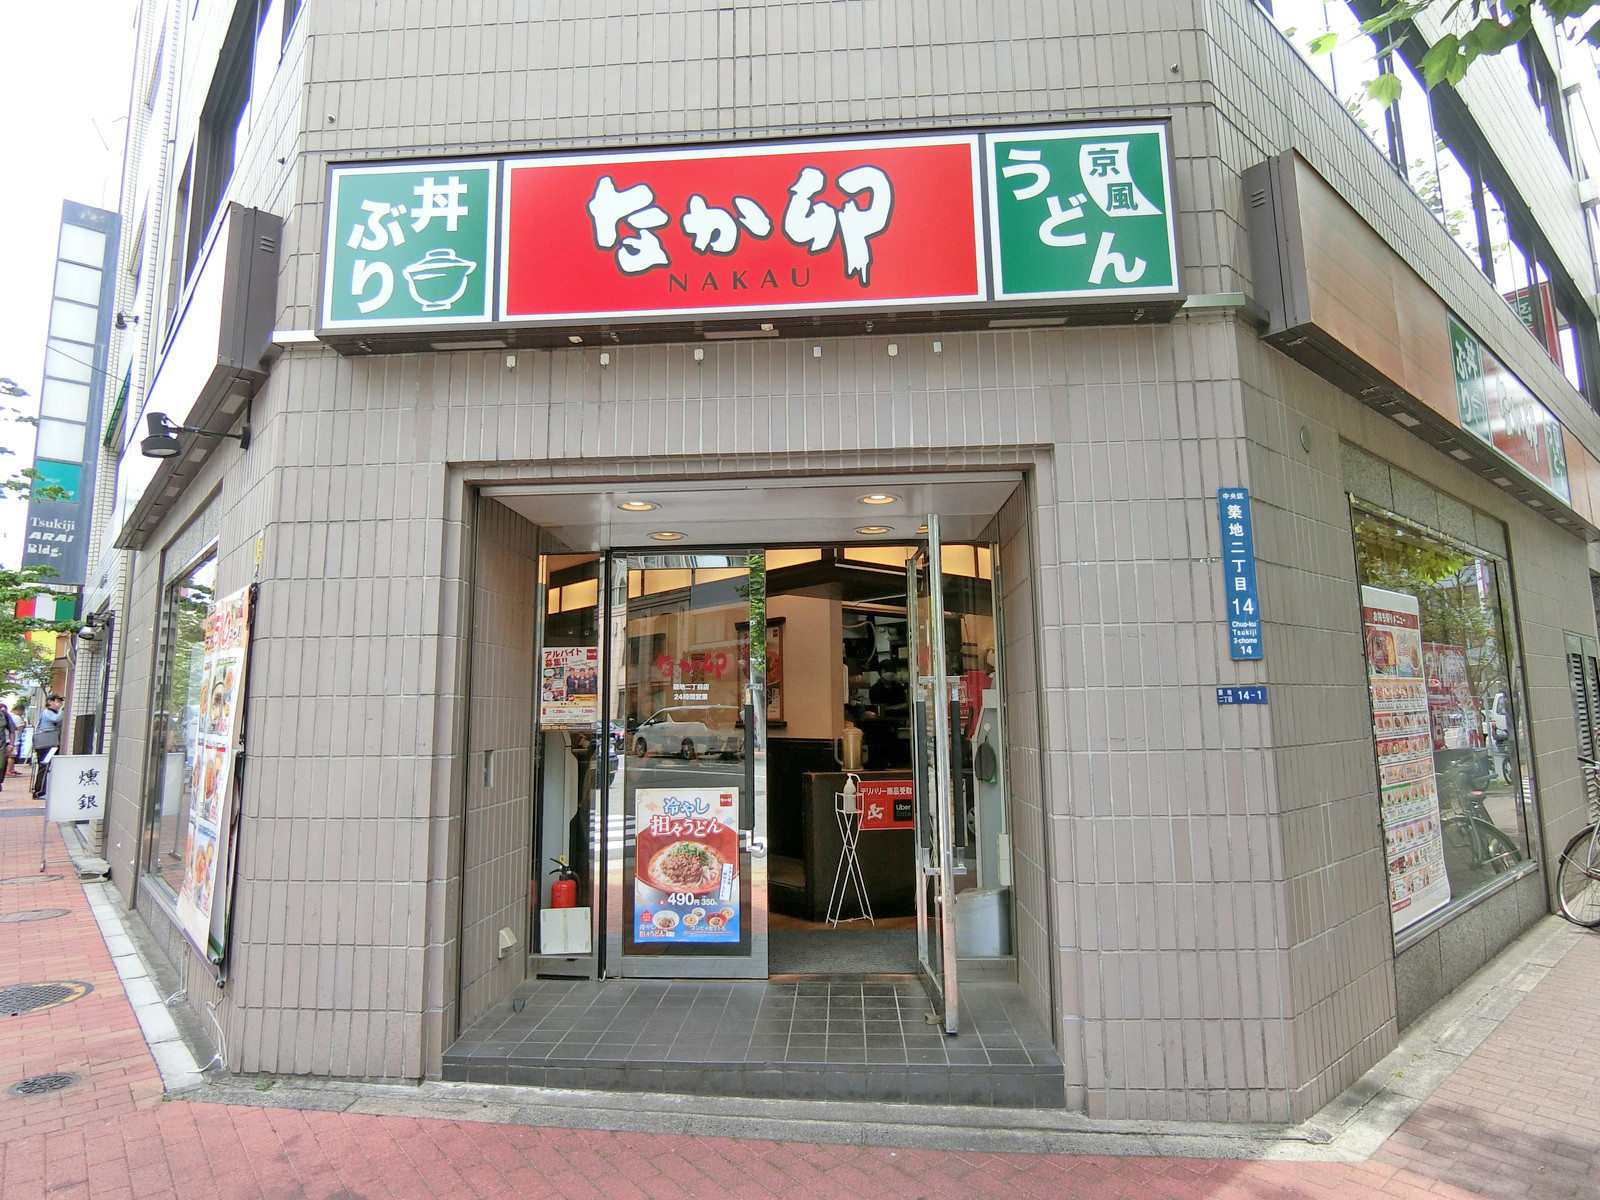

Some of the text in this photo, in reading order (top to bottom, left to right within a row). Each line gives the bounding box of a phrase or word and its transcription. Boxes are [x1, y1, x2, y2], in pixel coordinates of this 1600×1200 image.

[1089, 148, 1138, 212] 京風
[588, 163, 893, 288] なか卯
[1001, 148, 1147, 285] うどん
[669, 267, 810, 293] NAKAU
[31, 517, 76, 532] Tsukiji
[28, 531, 75, 543] ARAI
[27, 543, 62, 557] Bldg.
[1227, 504, 1254, 615] 築地二丁目 14
[544, 648, 582, 659] アルバイト
[1240, 645, 1253, 655] 14
[1238, 690, 1262, 700] 14-1
[663, 797, 710, 817] 冷やし
[650, 815, 723, 837] 担々うどん
